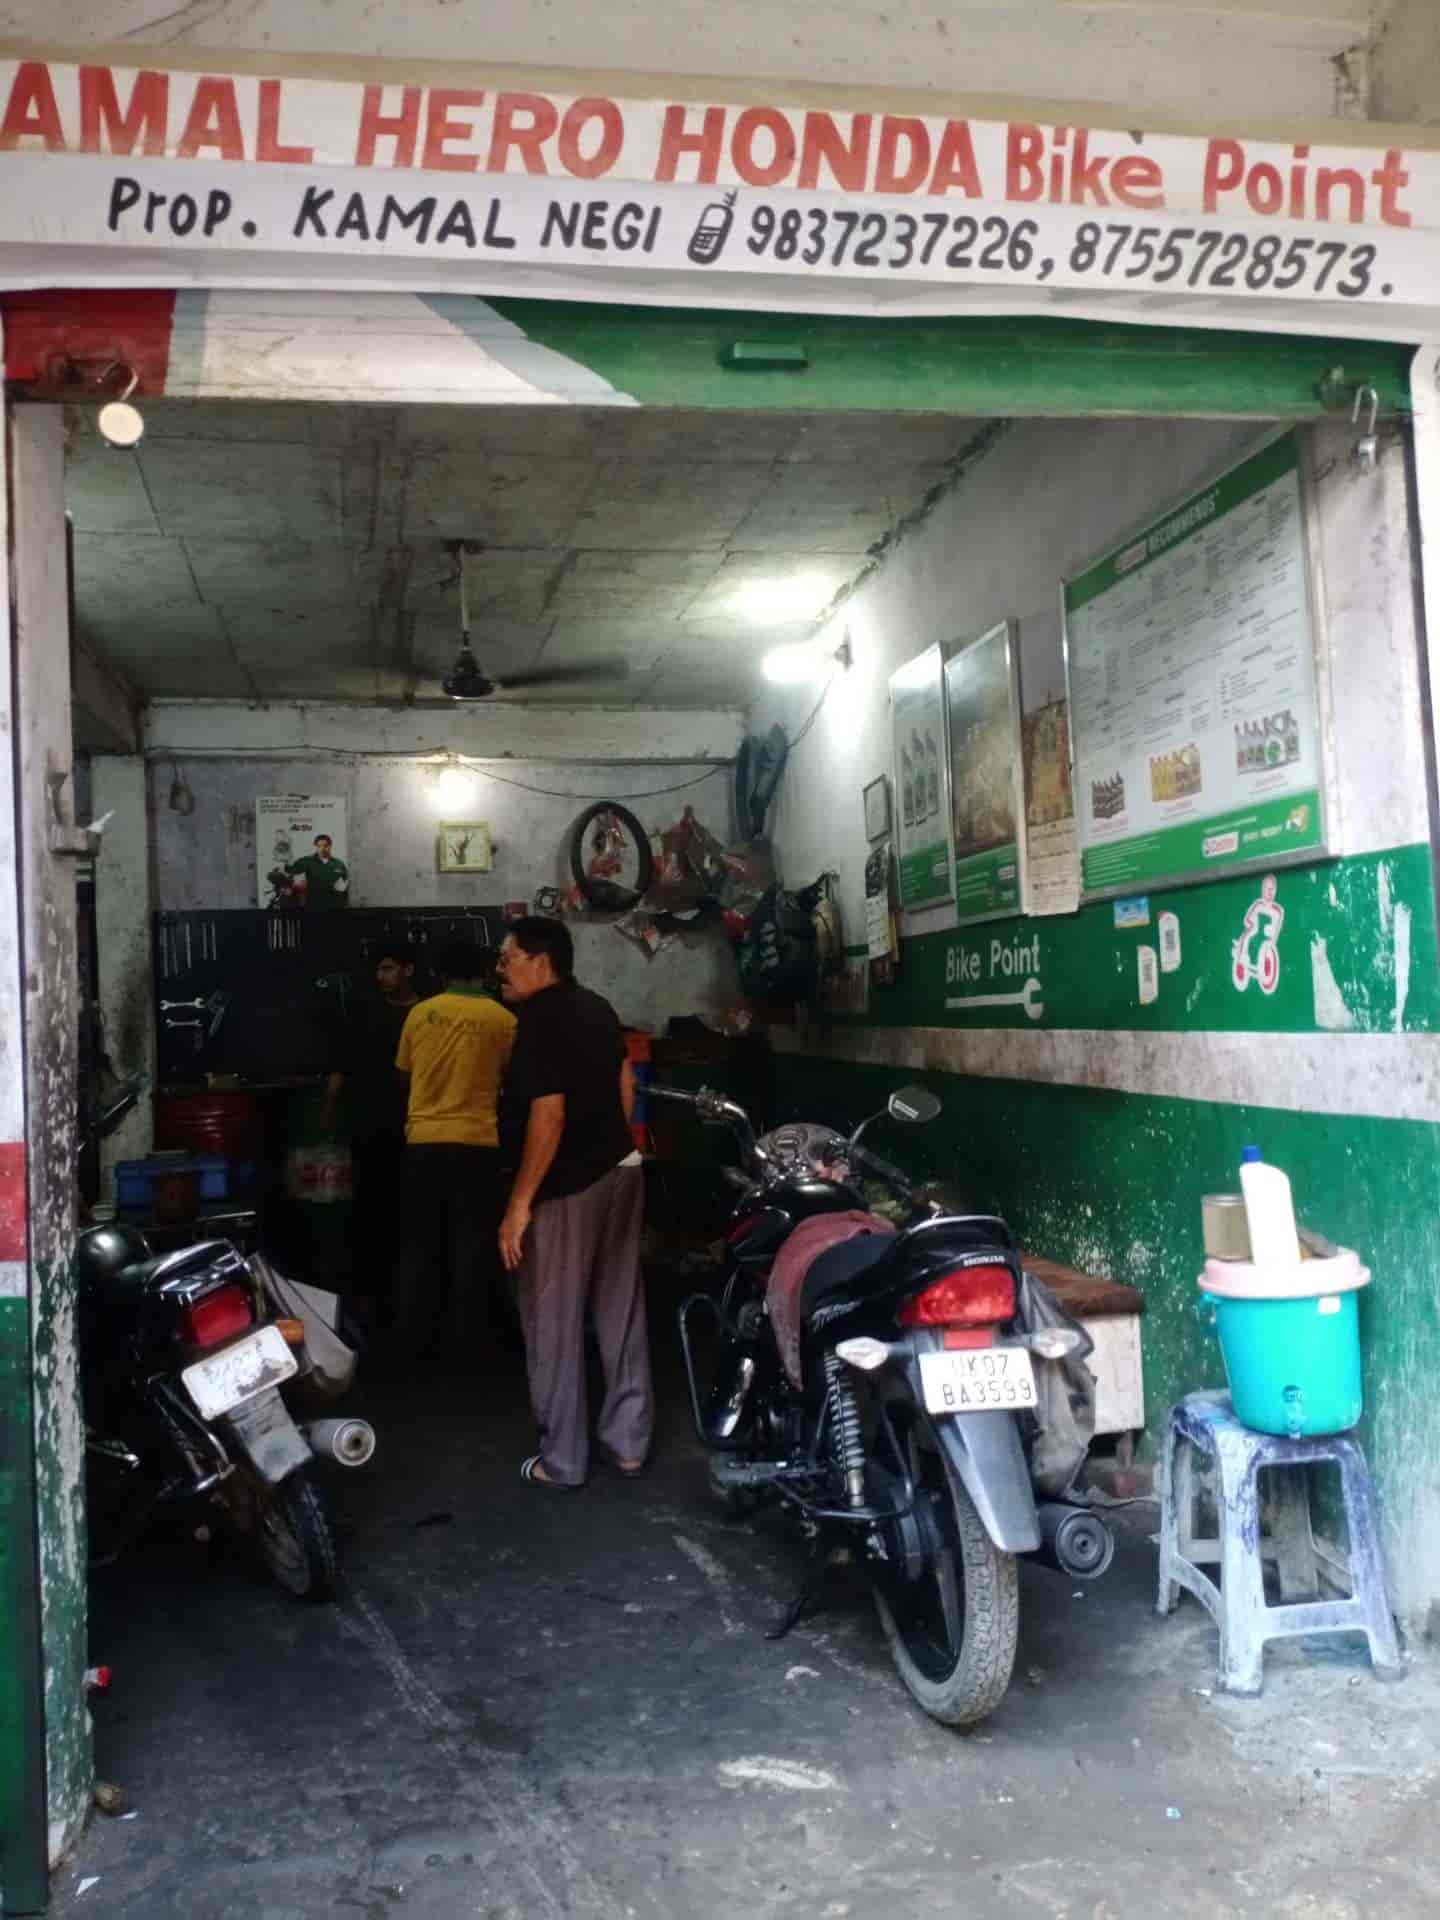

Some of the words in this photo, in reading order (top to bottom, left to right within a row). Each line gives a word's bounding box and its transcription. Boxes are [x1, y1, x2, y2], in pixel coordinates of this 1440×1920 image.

[0, 61, 313, 164] AMAL
[355, 85, 625, 180] HERO
[654, 102, 983, 200] HONDA
[1005, 122, 1166, 211] Bike
[1203, 136, 1413, 229] Point
[293, 186, 516, 249] KAMAL
[540, 199, 662, 254] NEGI
[746, 203, 1055, 281] 9837237226,
[1068, 221, 1395, 297] 8755728573.
[944, 945, 981, 984] Bike
[990, 933, 1041, 977] Point
